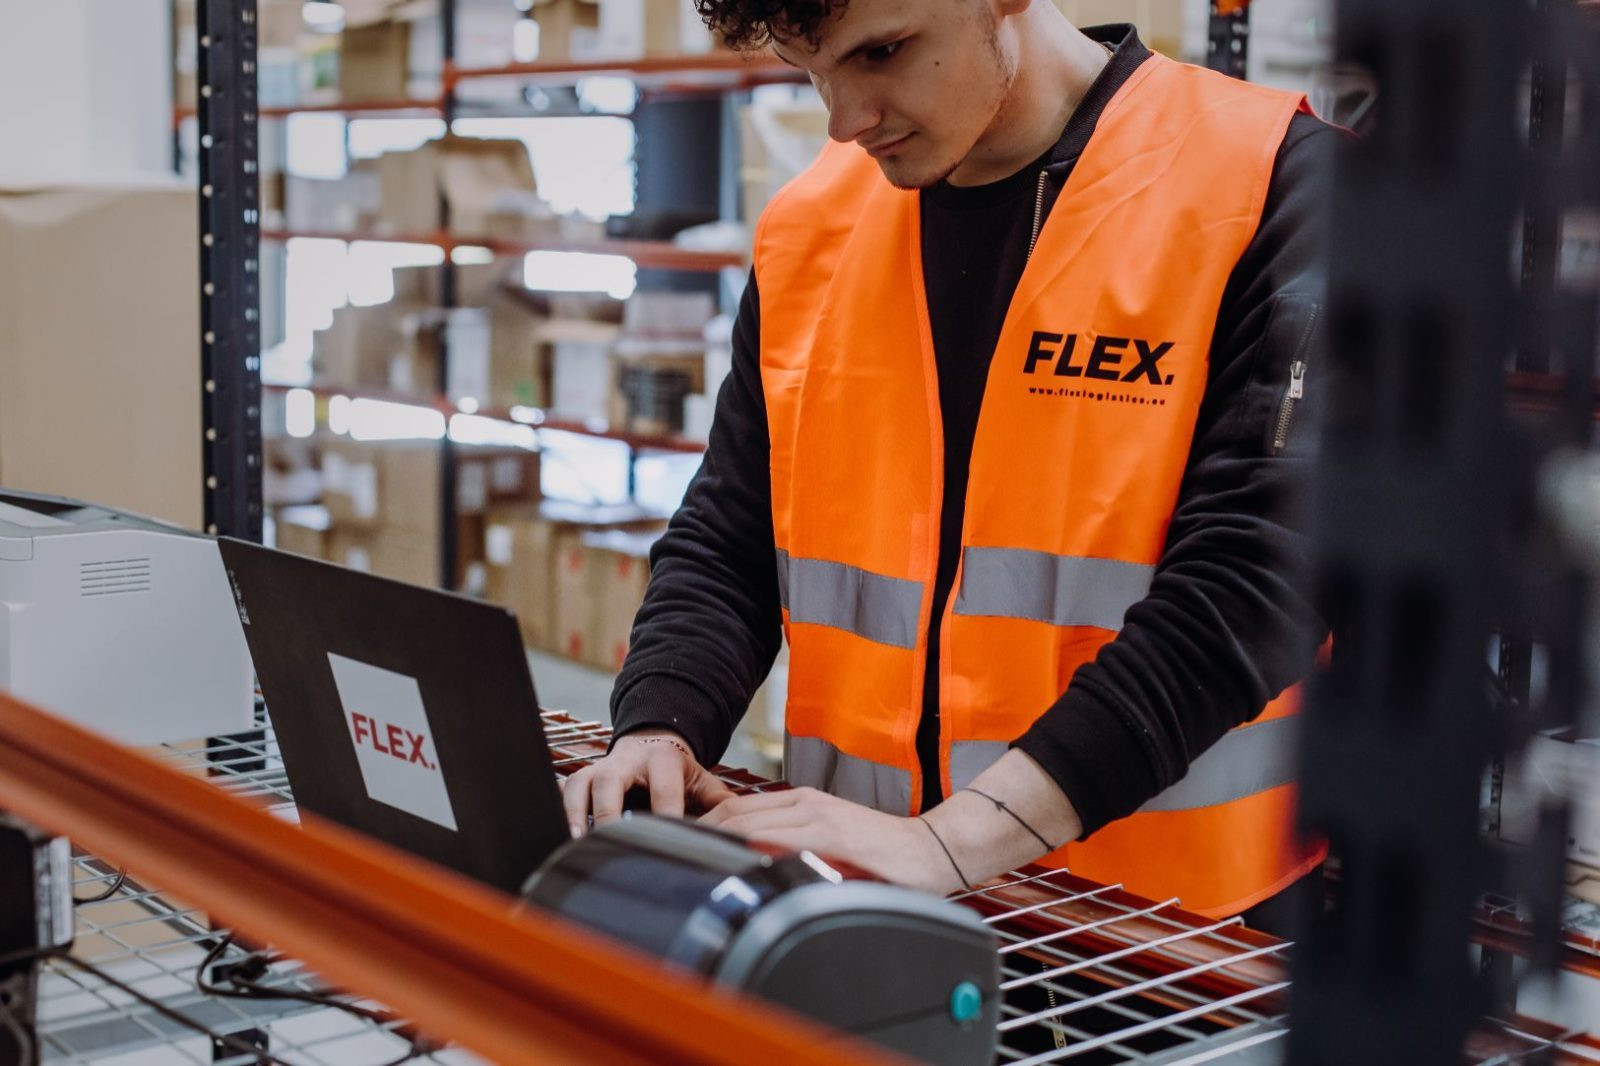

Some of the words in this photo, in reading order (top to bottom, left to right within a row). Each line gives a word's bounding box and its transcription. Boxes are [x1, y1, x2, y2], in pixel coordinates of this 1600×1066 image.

[1023, 331, 1175, 386] FLEX.
[1029, 386, 1166, 406] www.flexlogistics.eu
[351, 711, 437, 771] FLEX.
